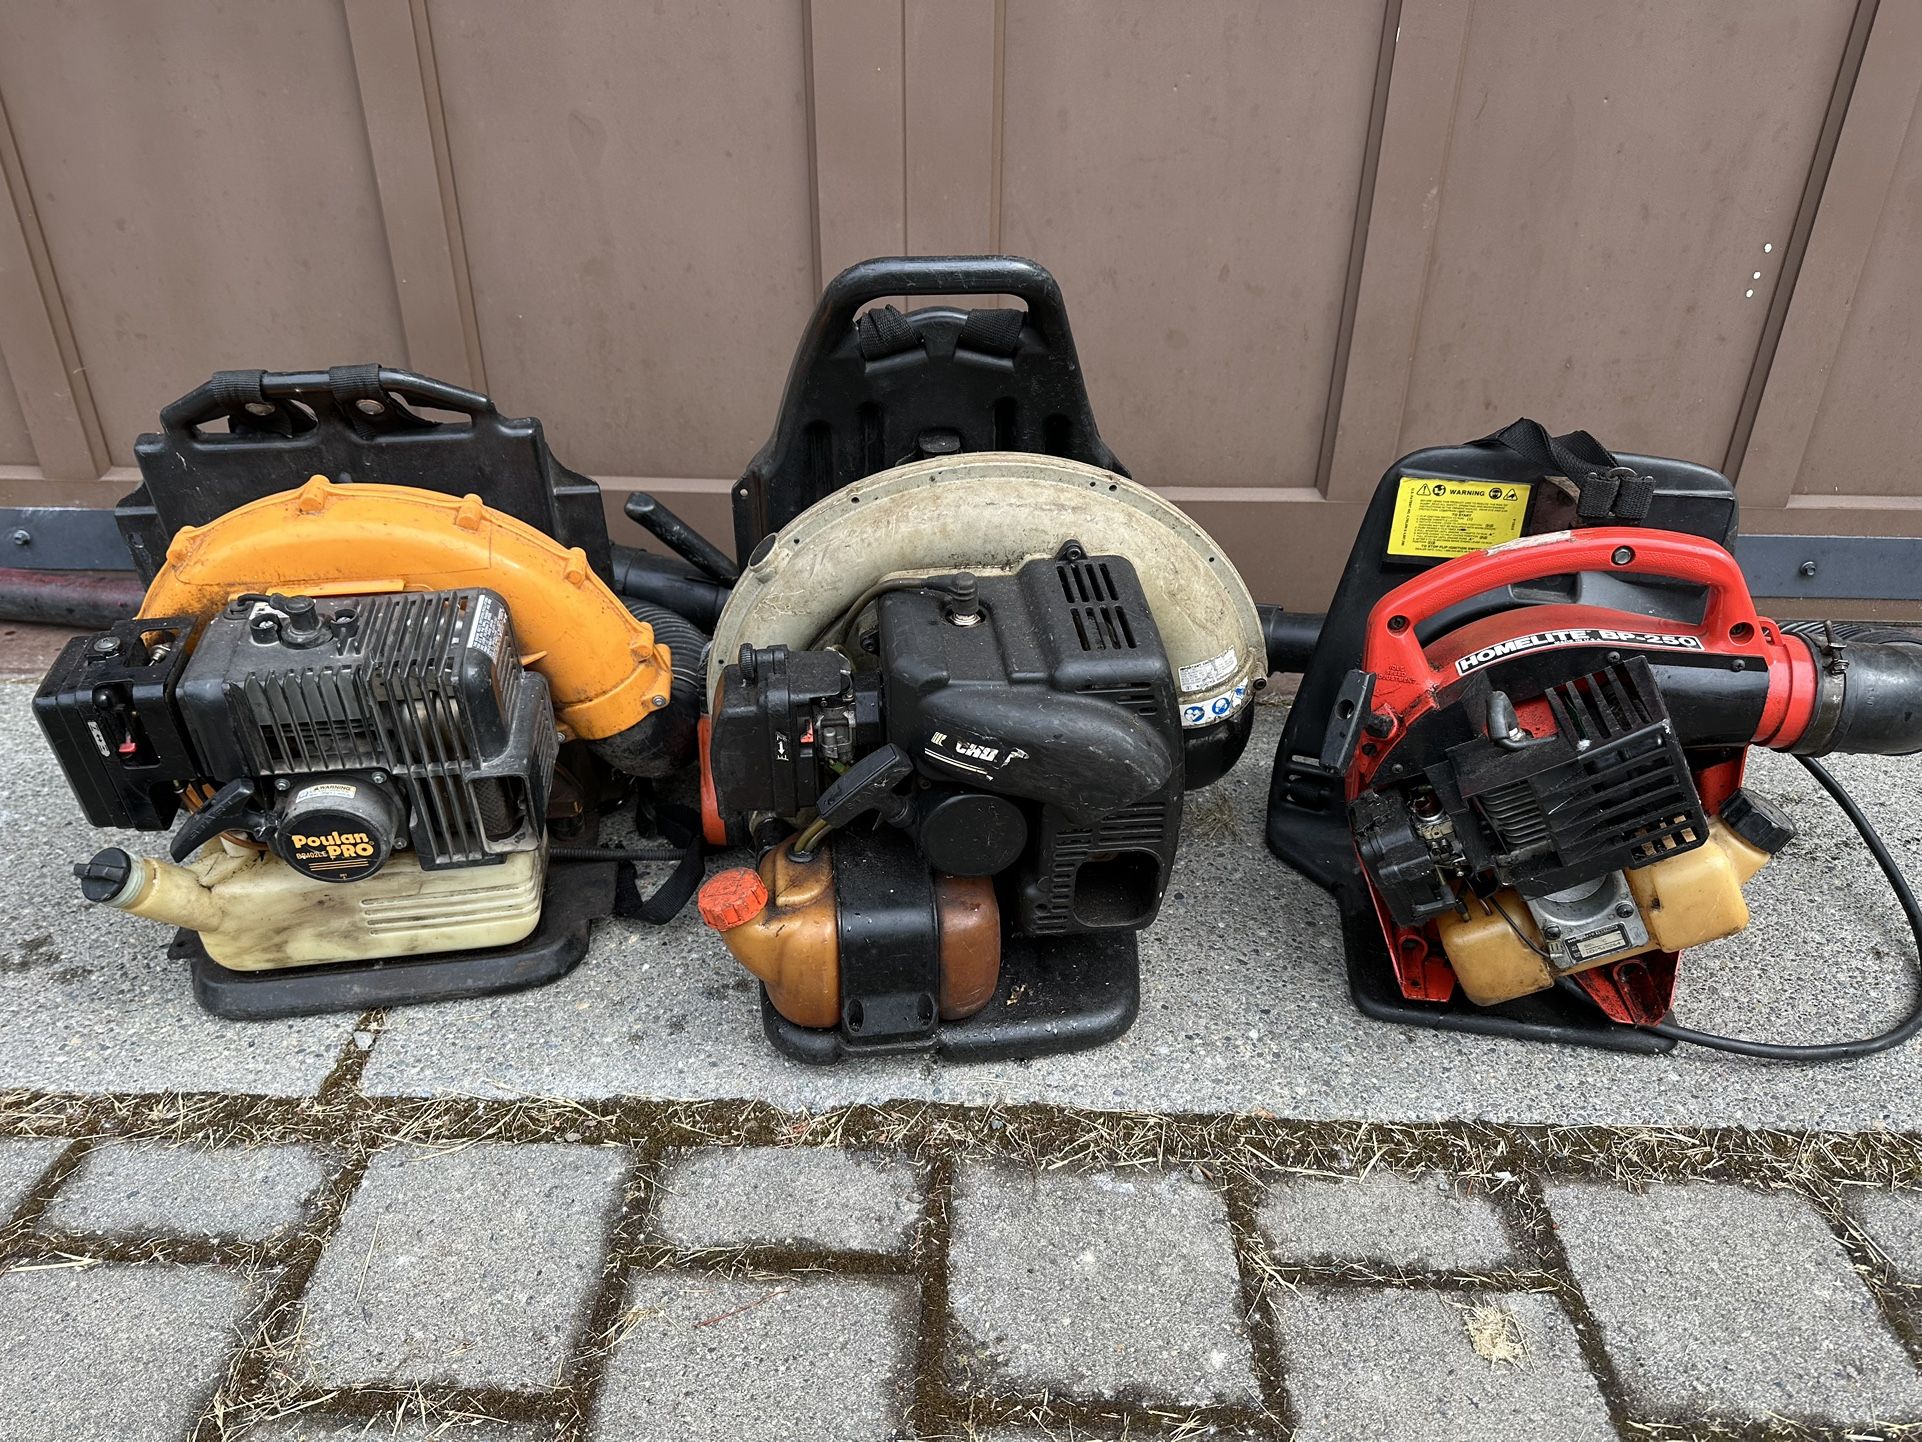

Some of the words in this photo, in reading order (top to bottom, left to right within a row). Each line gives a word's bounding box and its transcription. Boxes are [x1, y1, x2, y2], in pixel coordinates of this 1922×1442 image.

[1449, 488, 1485, 497] WARNING
[1462, 630, 1590, 671] HOMELITE
[1599, 630, 1697, 647] BP-250
[291, 831, 369, 849] Poulan
[326, 843, 374, 858] PRO
